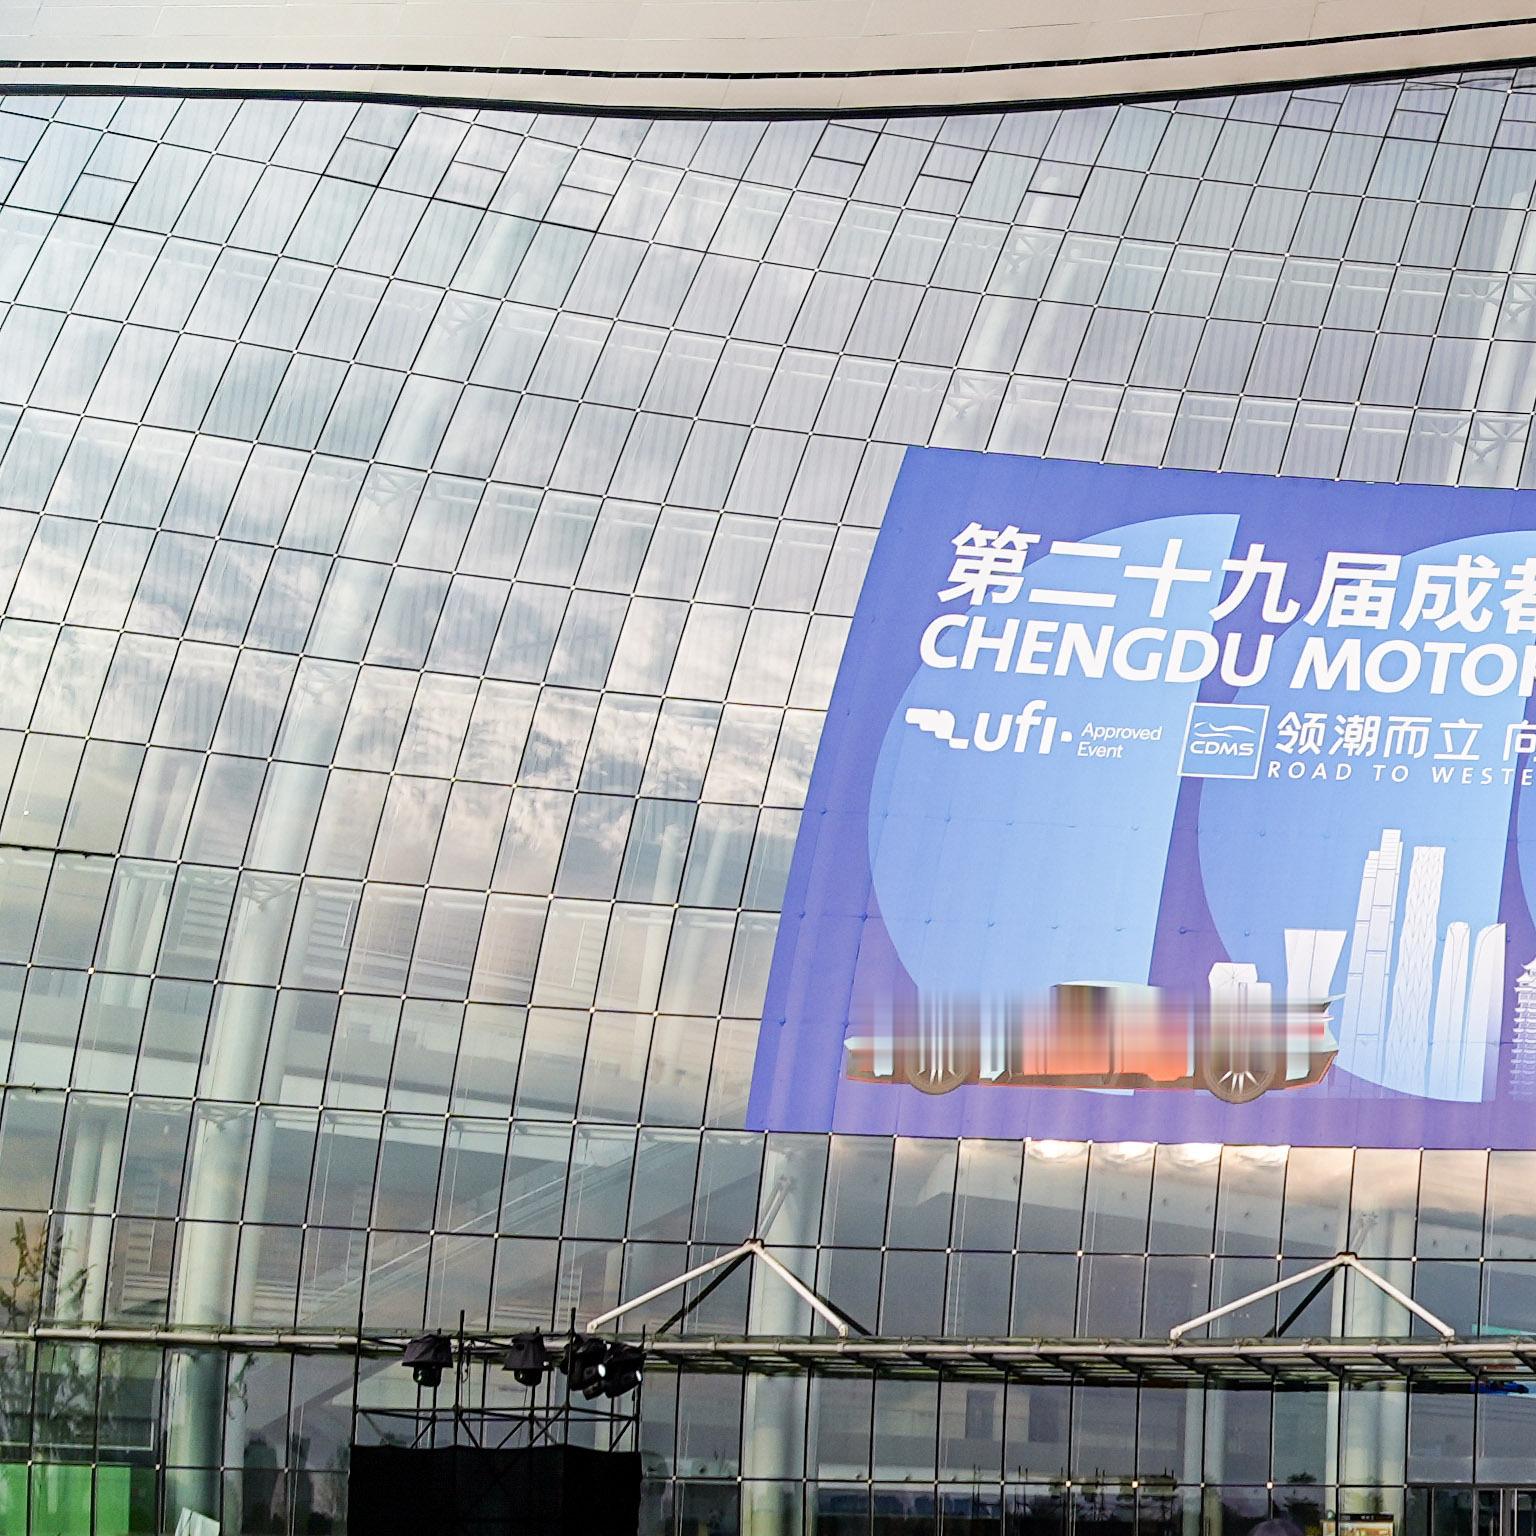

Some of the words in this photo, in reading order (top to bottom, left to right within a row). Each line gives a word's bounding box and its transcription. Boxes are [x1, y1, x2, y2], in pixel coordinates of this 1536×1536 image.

[918, 613, 1276, 688] CHENGDU
[1081, 722, 1163, 742] Approved
[1274, 711, 1484, 762] 领潮而立
[1076, 741, 1124, 760] Event
[1189, 740, 1255, 757] CDMS
[1267, 760, 1353, 782] ROAD
[1372, 764, 1410, 784] TO
